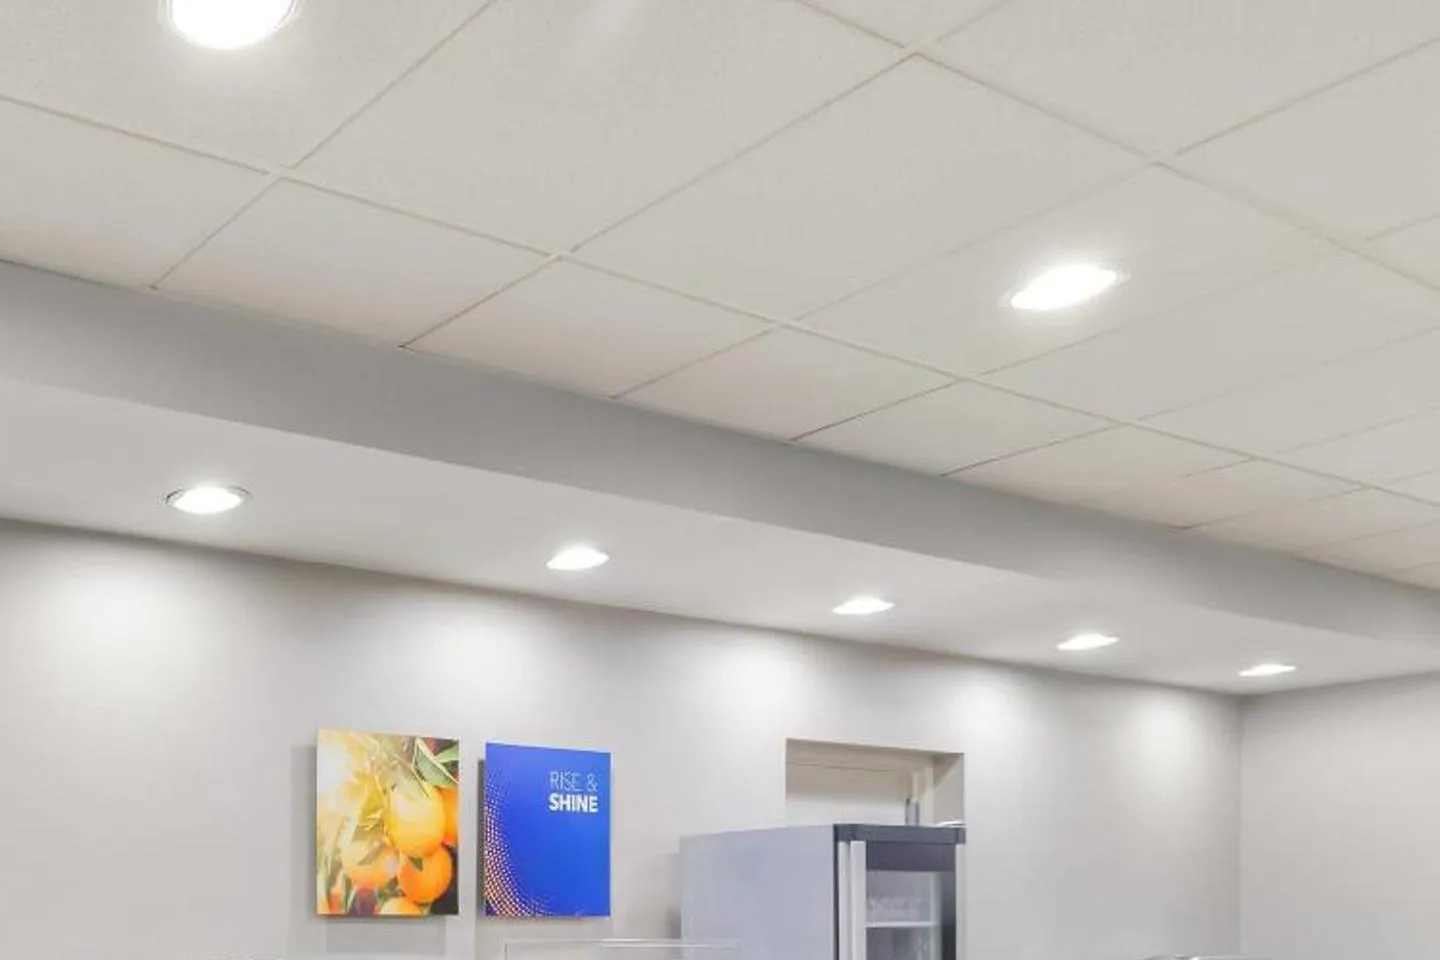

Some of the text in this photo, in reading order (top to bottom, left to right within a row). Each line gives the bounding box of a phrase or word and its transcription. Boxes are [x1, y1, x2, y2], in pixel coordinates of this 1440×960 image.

[550, 771, 598, 792] RISE &
[549, 793, 599, 813] SHINE
